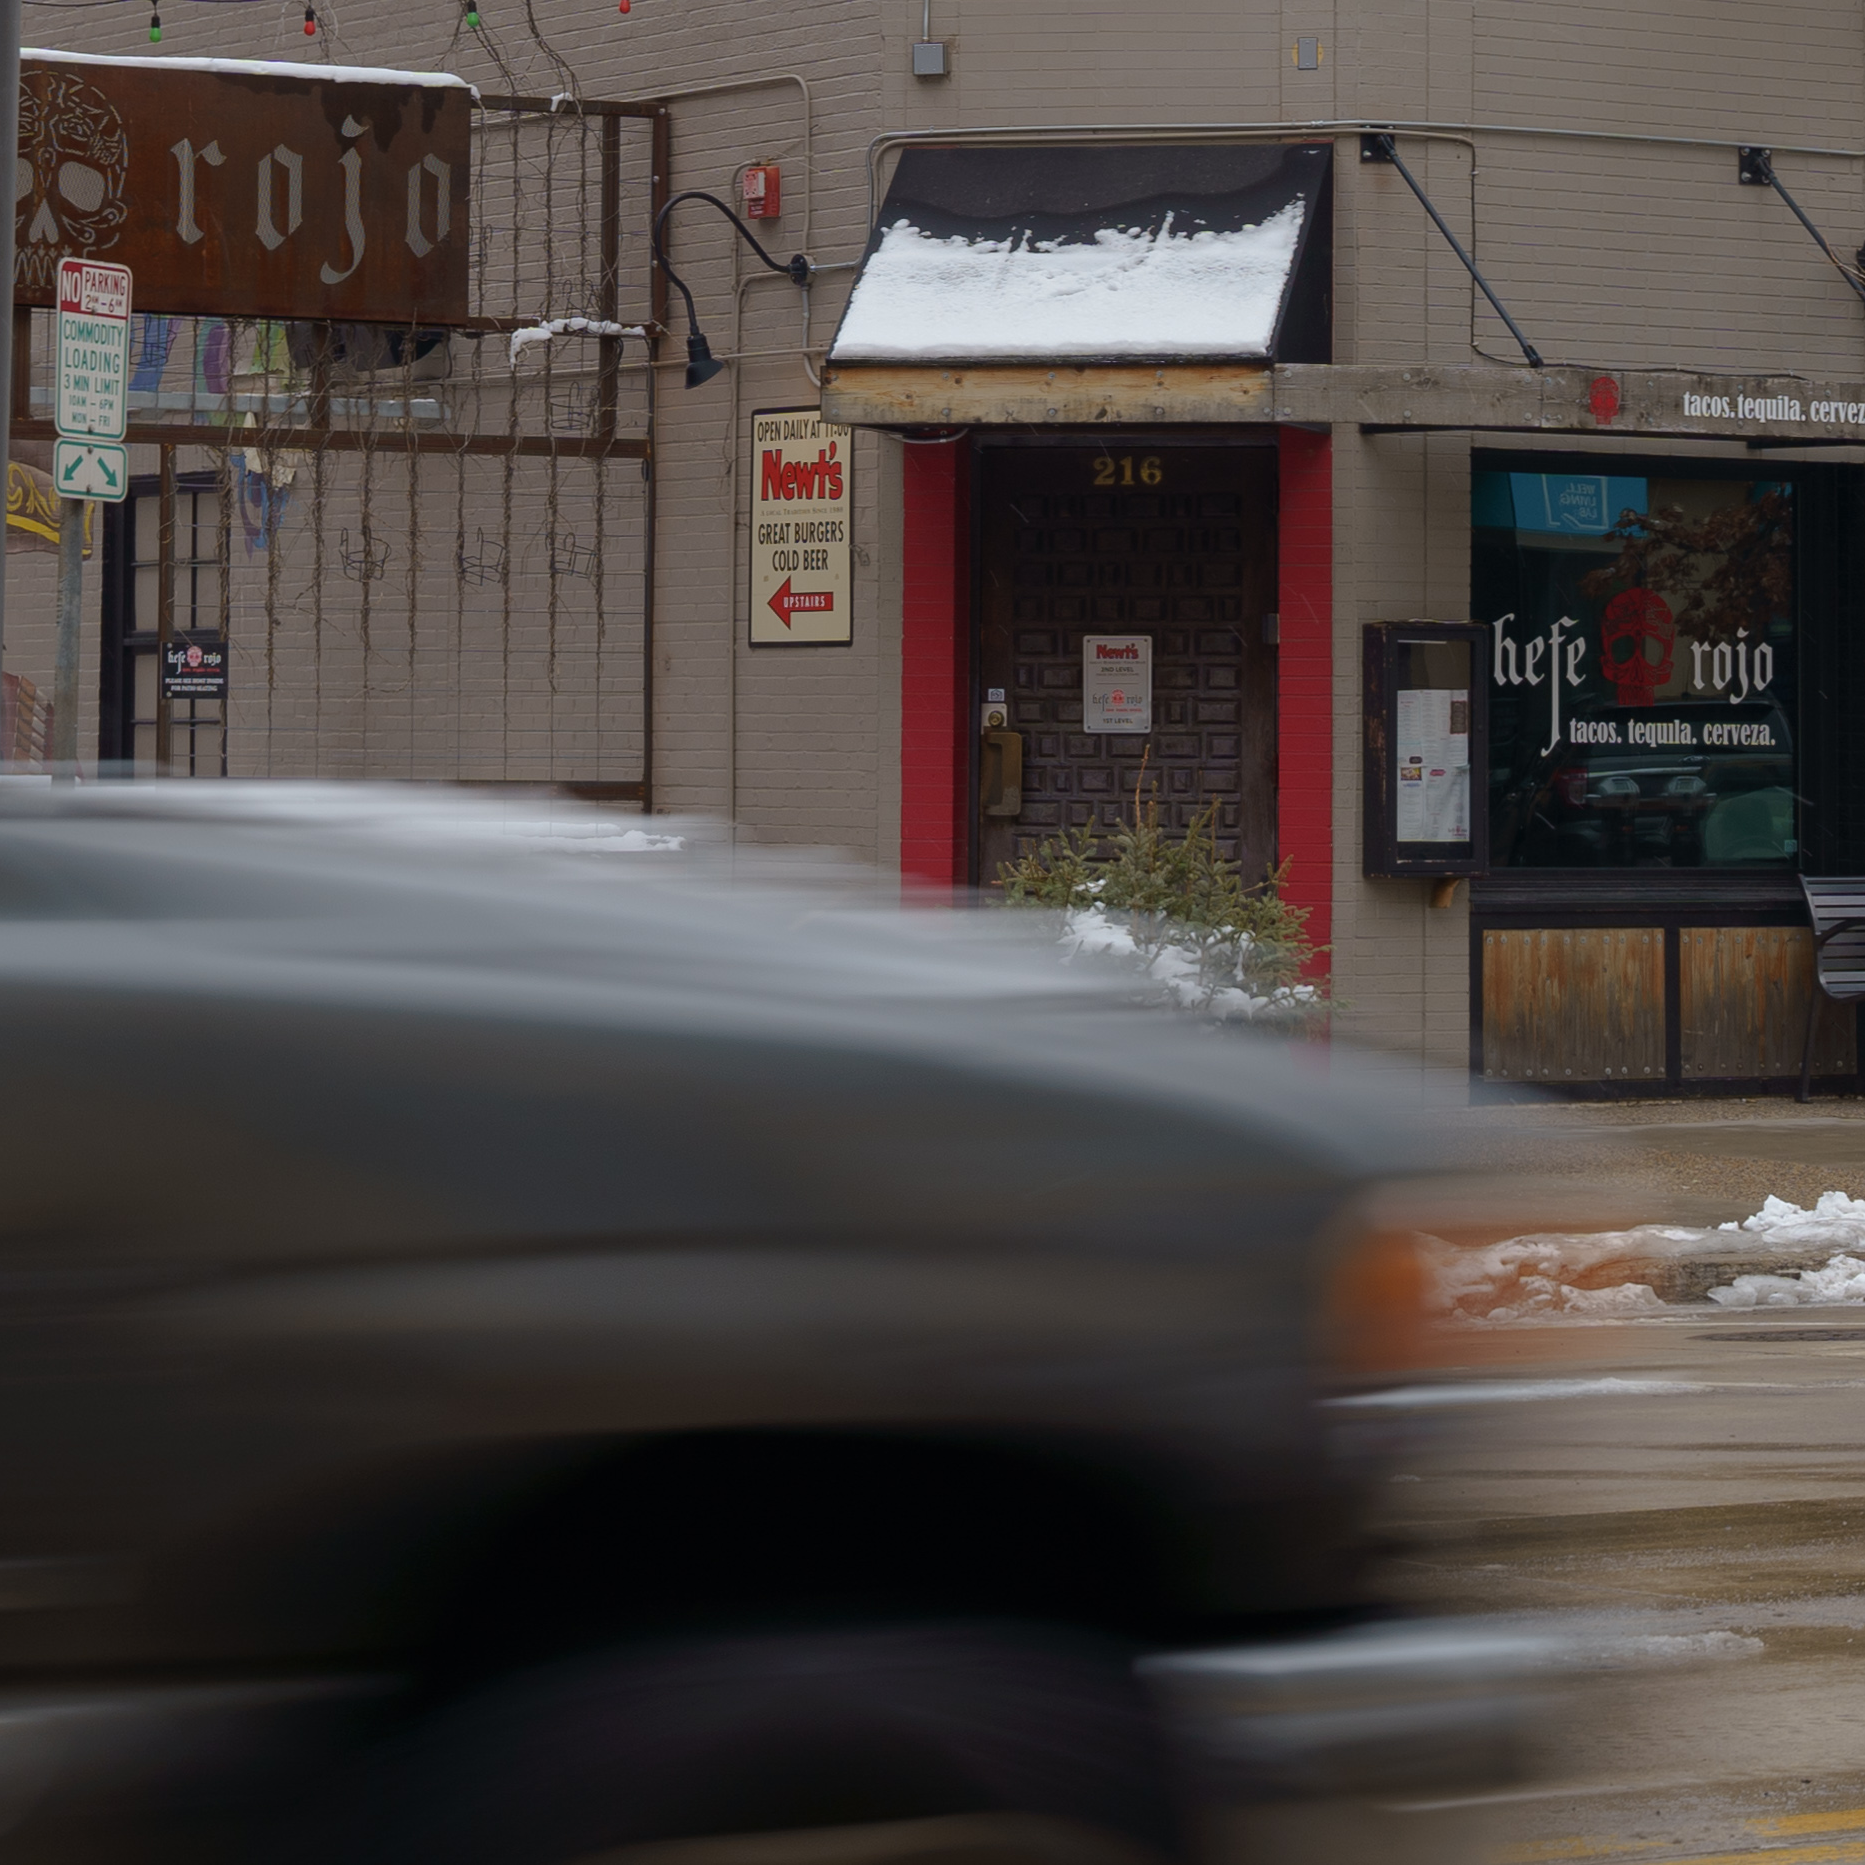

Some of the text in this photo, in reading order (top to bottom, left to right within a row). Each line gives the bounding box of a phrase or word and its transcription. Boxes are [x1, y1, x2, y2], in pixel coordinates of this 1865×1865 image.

[170, 114, 451, 285] rojo
[62, 270, 126, 303] NO PARKING
[64, 319, 124, 347] COMMODITY
[65, 347, 120, 374] LOADING
[64, 373, 120, 396] 3 MIN LIMIT
[68, 395, 114, 411] 10AM 6PM
[1683, 390, 1735, 419] tacos.
[1737, 392, 1806, 423] tequila.
[71, 411, 110, 427] MON FRI
[757, 421, 782, 442] OPEN
[784, 419, 810, 440] DAILY
[810, 419, 820, 438] AT
[761, 441, 843, 501] Newt's
[1092, 456, 1162, 486] 216
[758, 520, 844, 545] GREAT BURGERS
[772, 549, 828, 572] COLD BEER
[783, 596, 825, 608] UPSTAIRS
[203, 652, 221, 666] rojo
[1096, 643, 1139, 659] Newt's
[1493, 612, 1774, 757] hefe rojo
[1569, 717, 1776, 748] tacos. tequila. cerveza.
